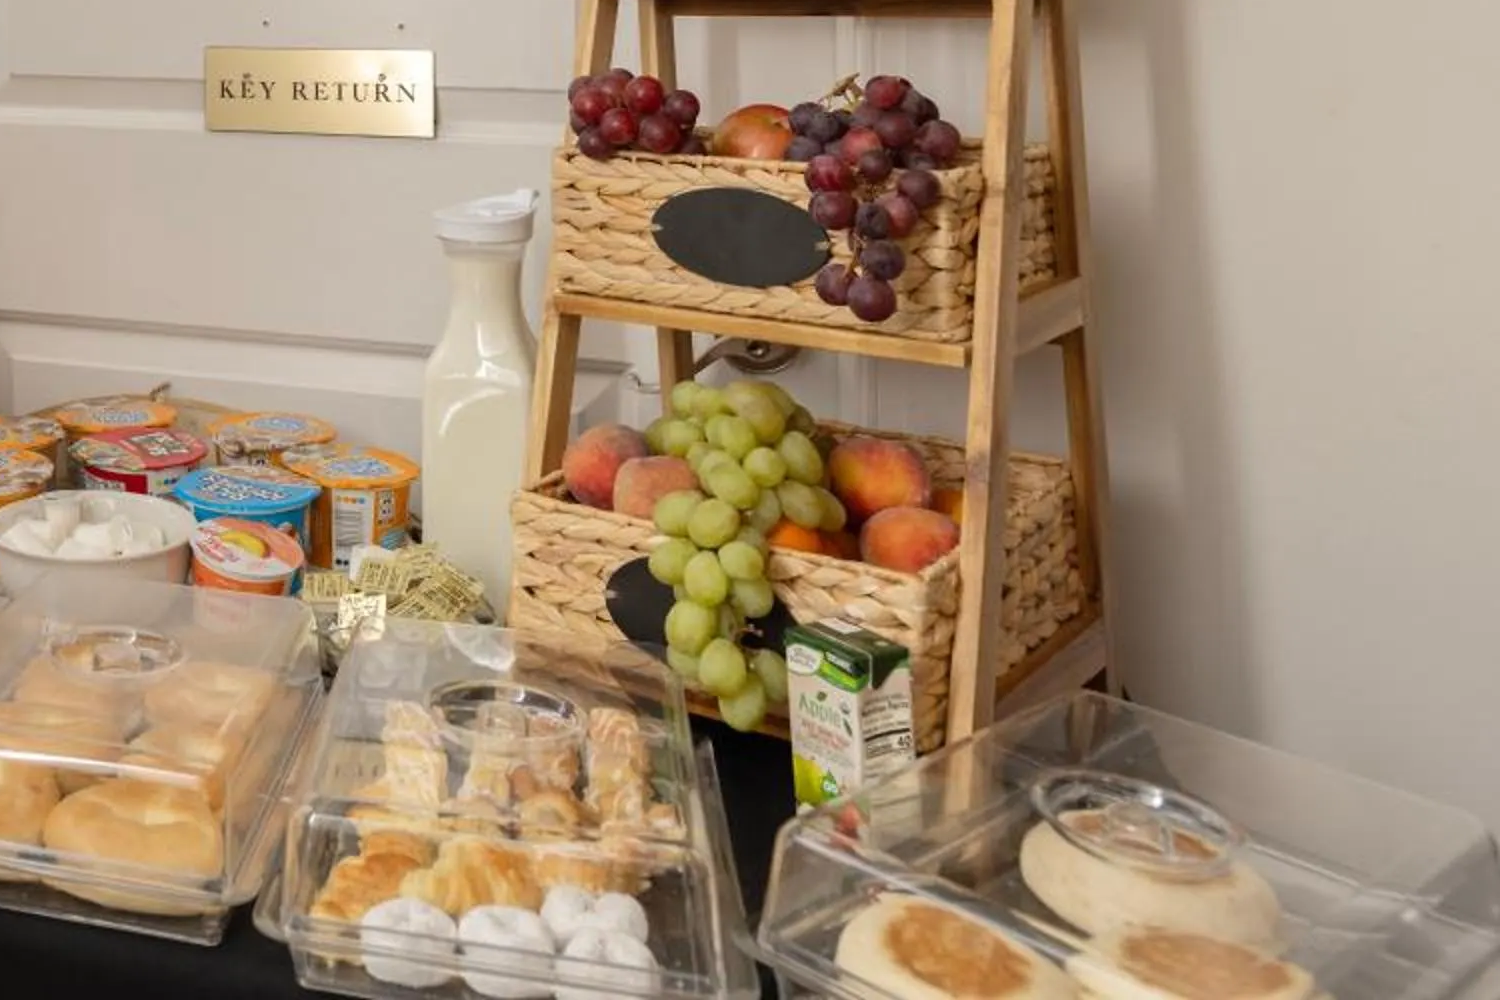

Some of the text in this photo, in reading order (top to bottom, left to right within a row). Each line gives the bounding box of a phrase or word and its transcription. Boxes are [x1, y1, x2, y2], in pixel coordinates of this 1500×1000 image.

[219, 79, 416, 103] KEY RETURN
[799, 692, 841, 729] Apple
